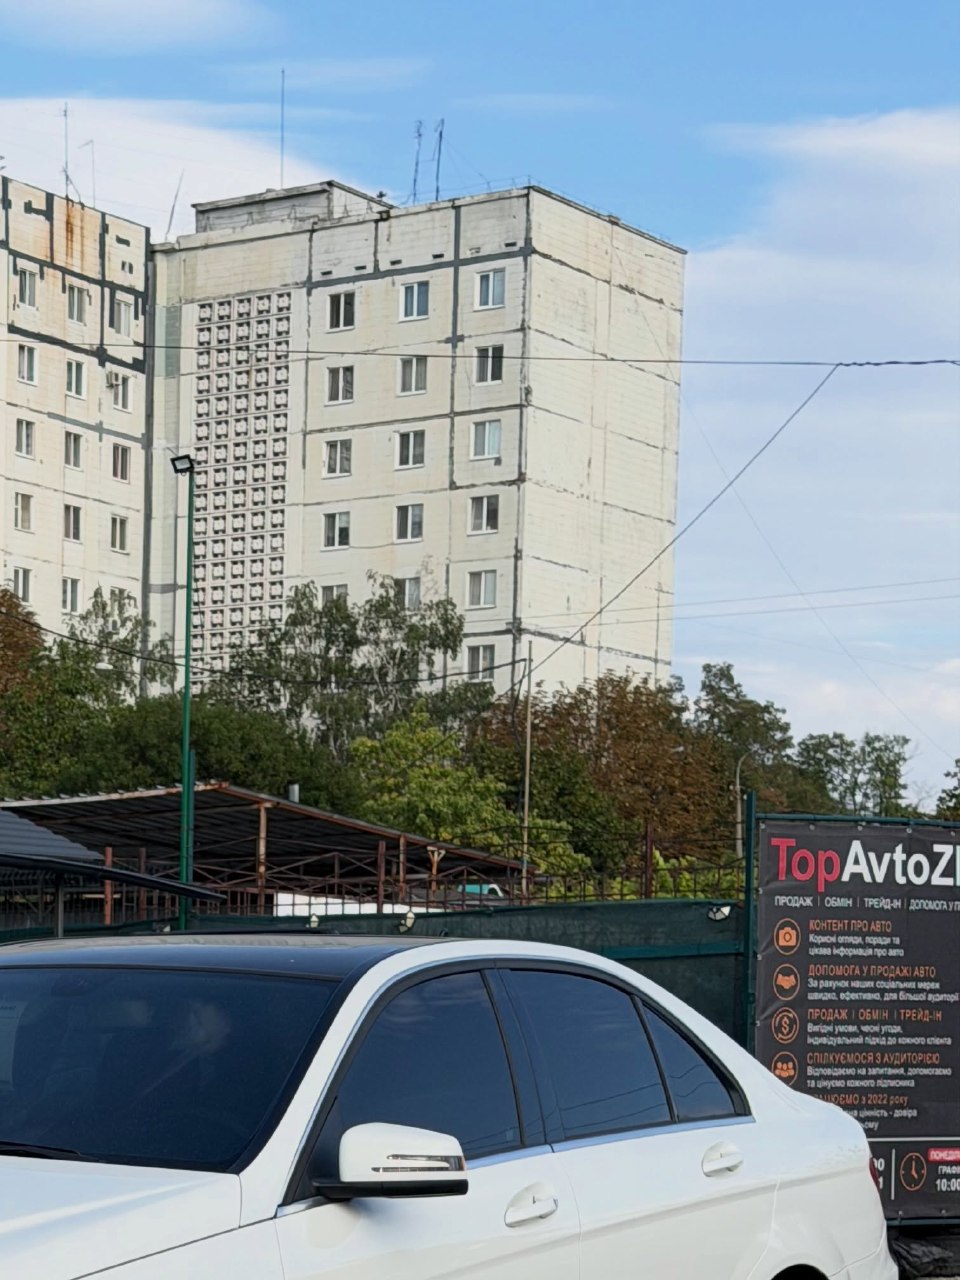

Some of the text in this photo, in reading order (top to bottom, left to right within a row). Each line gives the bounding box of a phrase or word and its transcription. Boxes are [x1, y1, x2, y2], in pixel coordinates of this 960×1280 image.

[774, 895, 814, 908] ПРОДАЖ
[824, 896, 853, 908] ОБМІН
[908, 899, 948, 912] ДОПОМОГА
[809, 920, 892, 933] КОНТЕНТ ПРО АВТО
[874, 948, 887, 958] про
[887, 948, 905, 957] авто
[808, 964, 936, 978] ДОПОМОГА У ПРОДАЖІ АВТО
[808, 978, 818, 988] За
[808, 1008, 942, 1021] ПРОДАЖ ОБМІН ТРЕЙД-ІН
[887, 1036, 897, 1046] до
[807, 1052, 874, 1064] СПІЛКУЄМОСЯ
[883, 1053, 940, 1066] АУДИТОРІЄЮ
[807, 1079, 816, 1088] та
[867, 1093, 888, 1105] 2022
[889, 1095, 908, 1107] року
[893, 1108, 918, 1119] довіра
